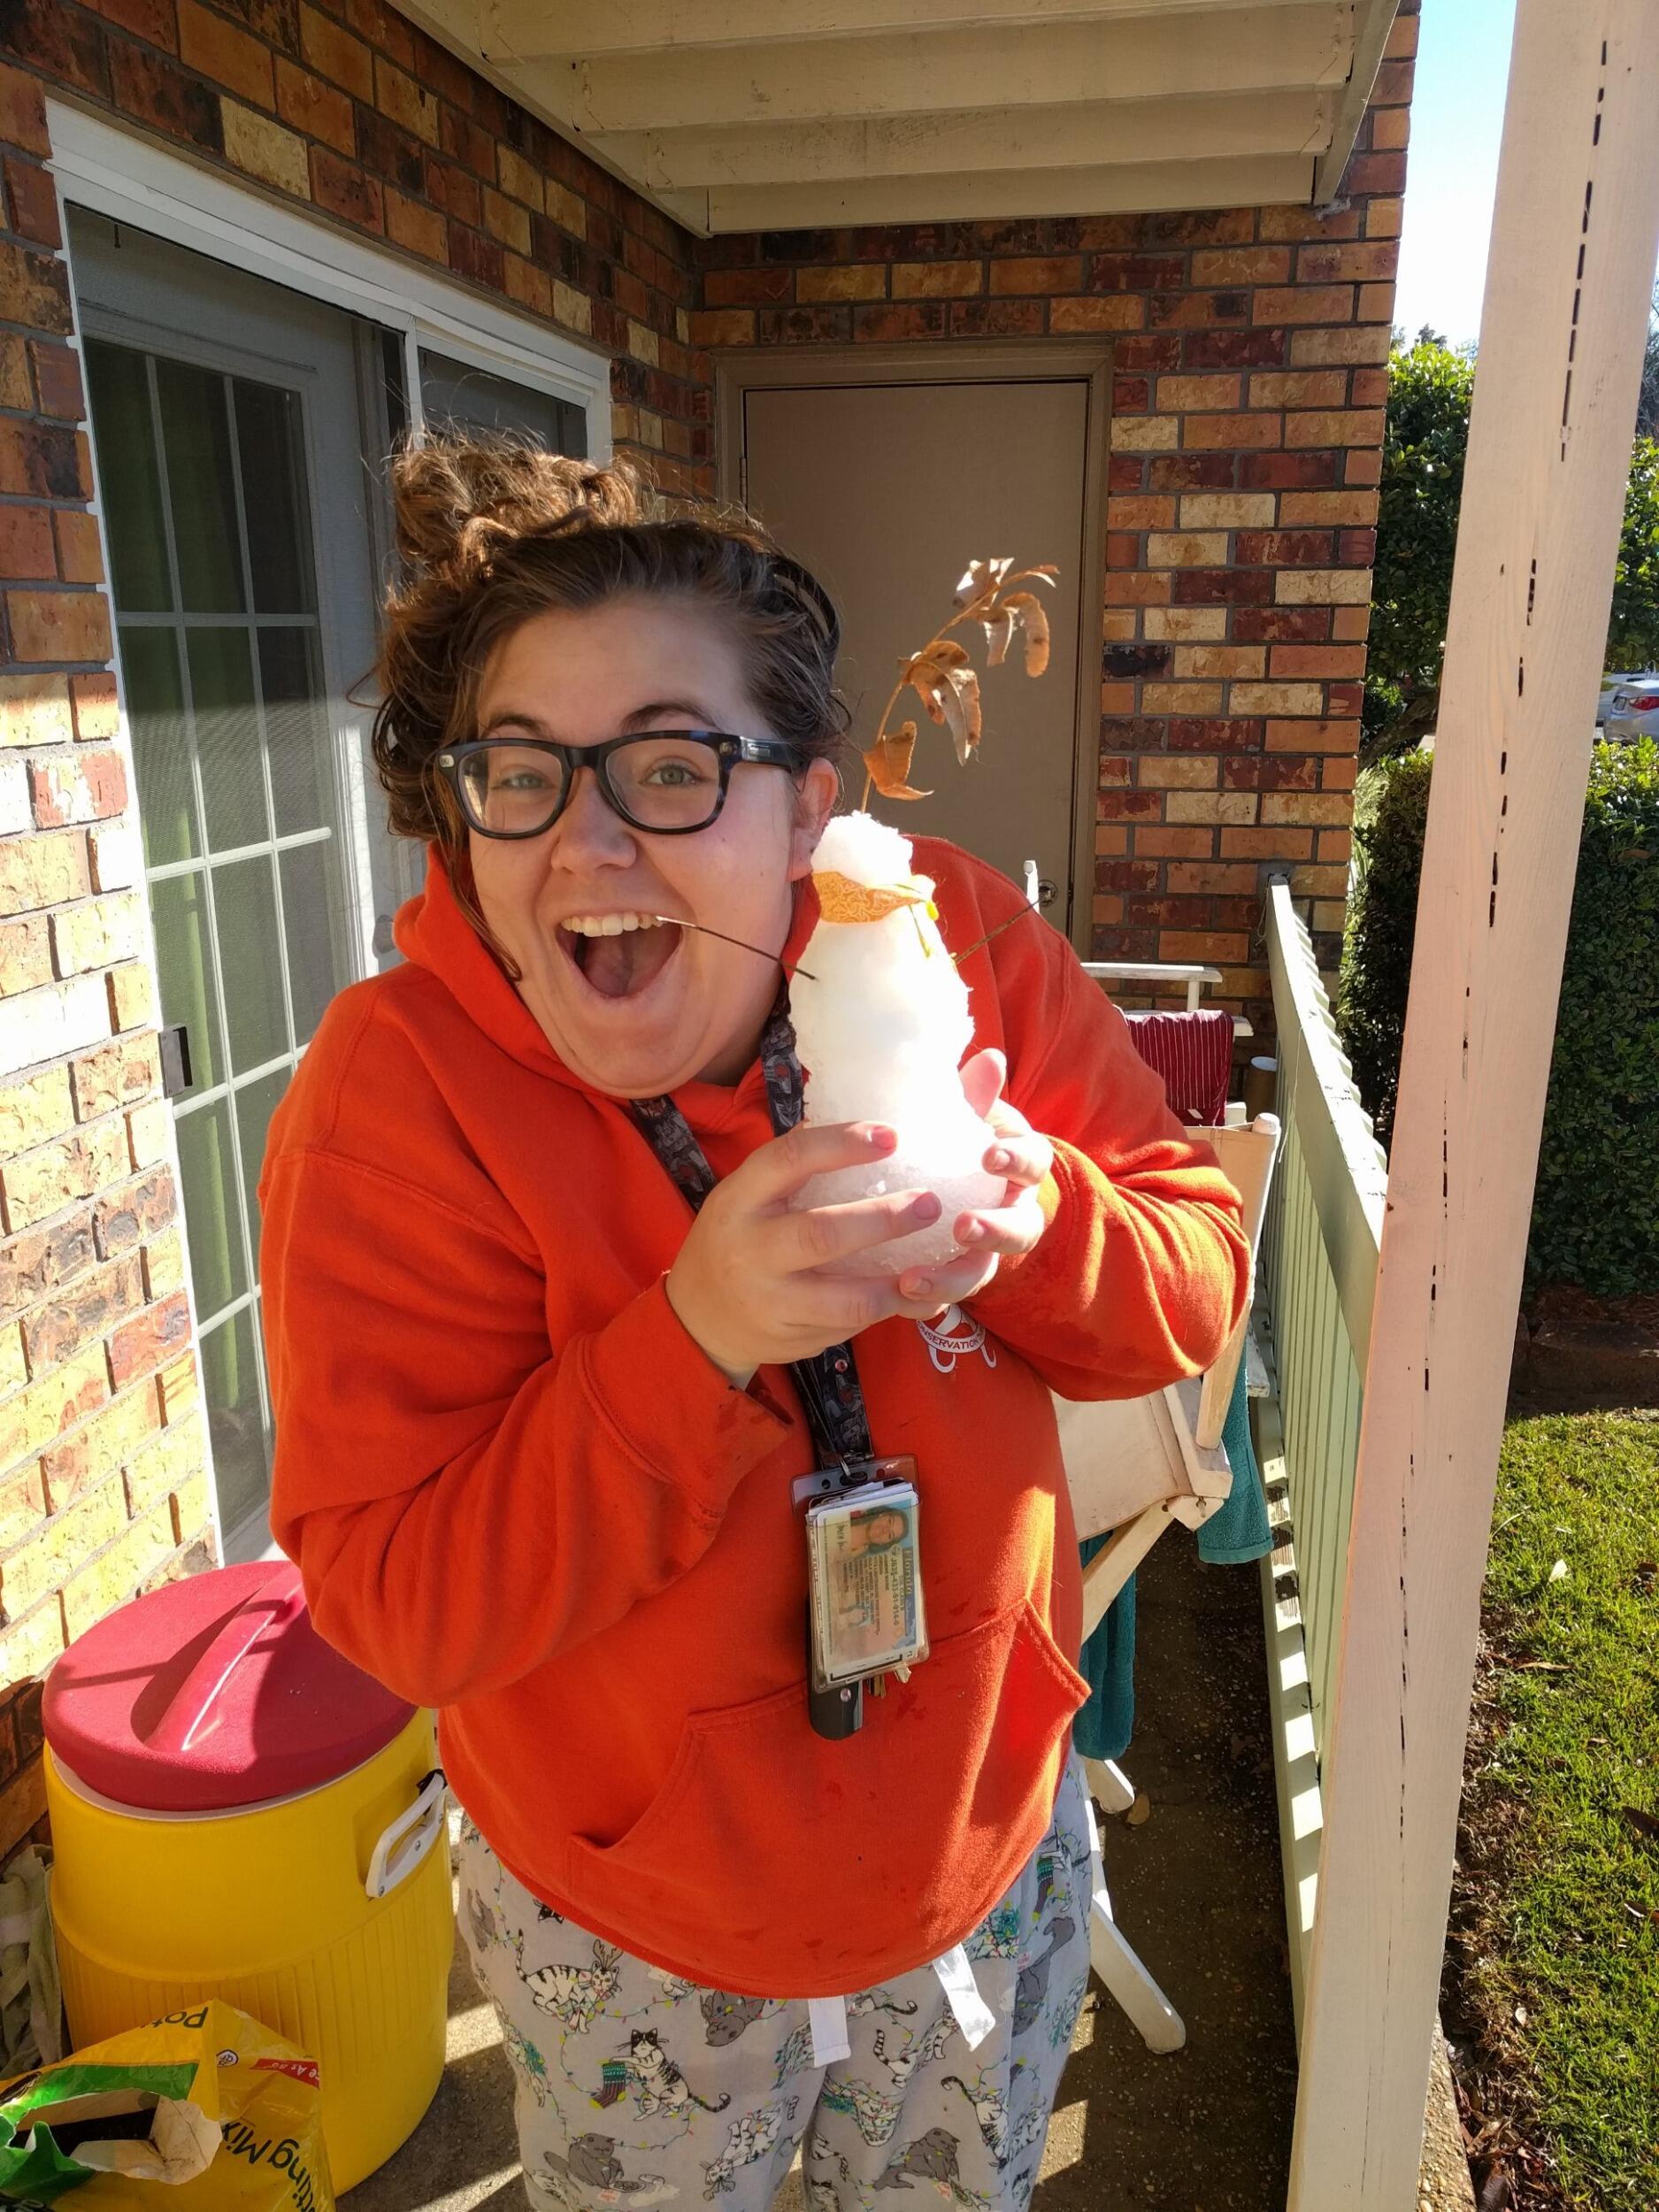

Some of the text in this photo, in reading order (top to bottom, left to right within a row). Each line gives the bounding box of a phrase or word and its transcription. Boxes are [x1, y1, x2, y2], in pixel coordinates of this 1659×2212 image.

[918, 1320, 979, 1350] ONSERVATION
[221, 2120, 315, 2212] tting Mix
